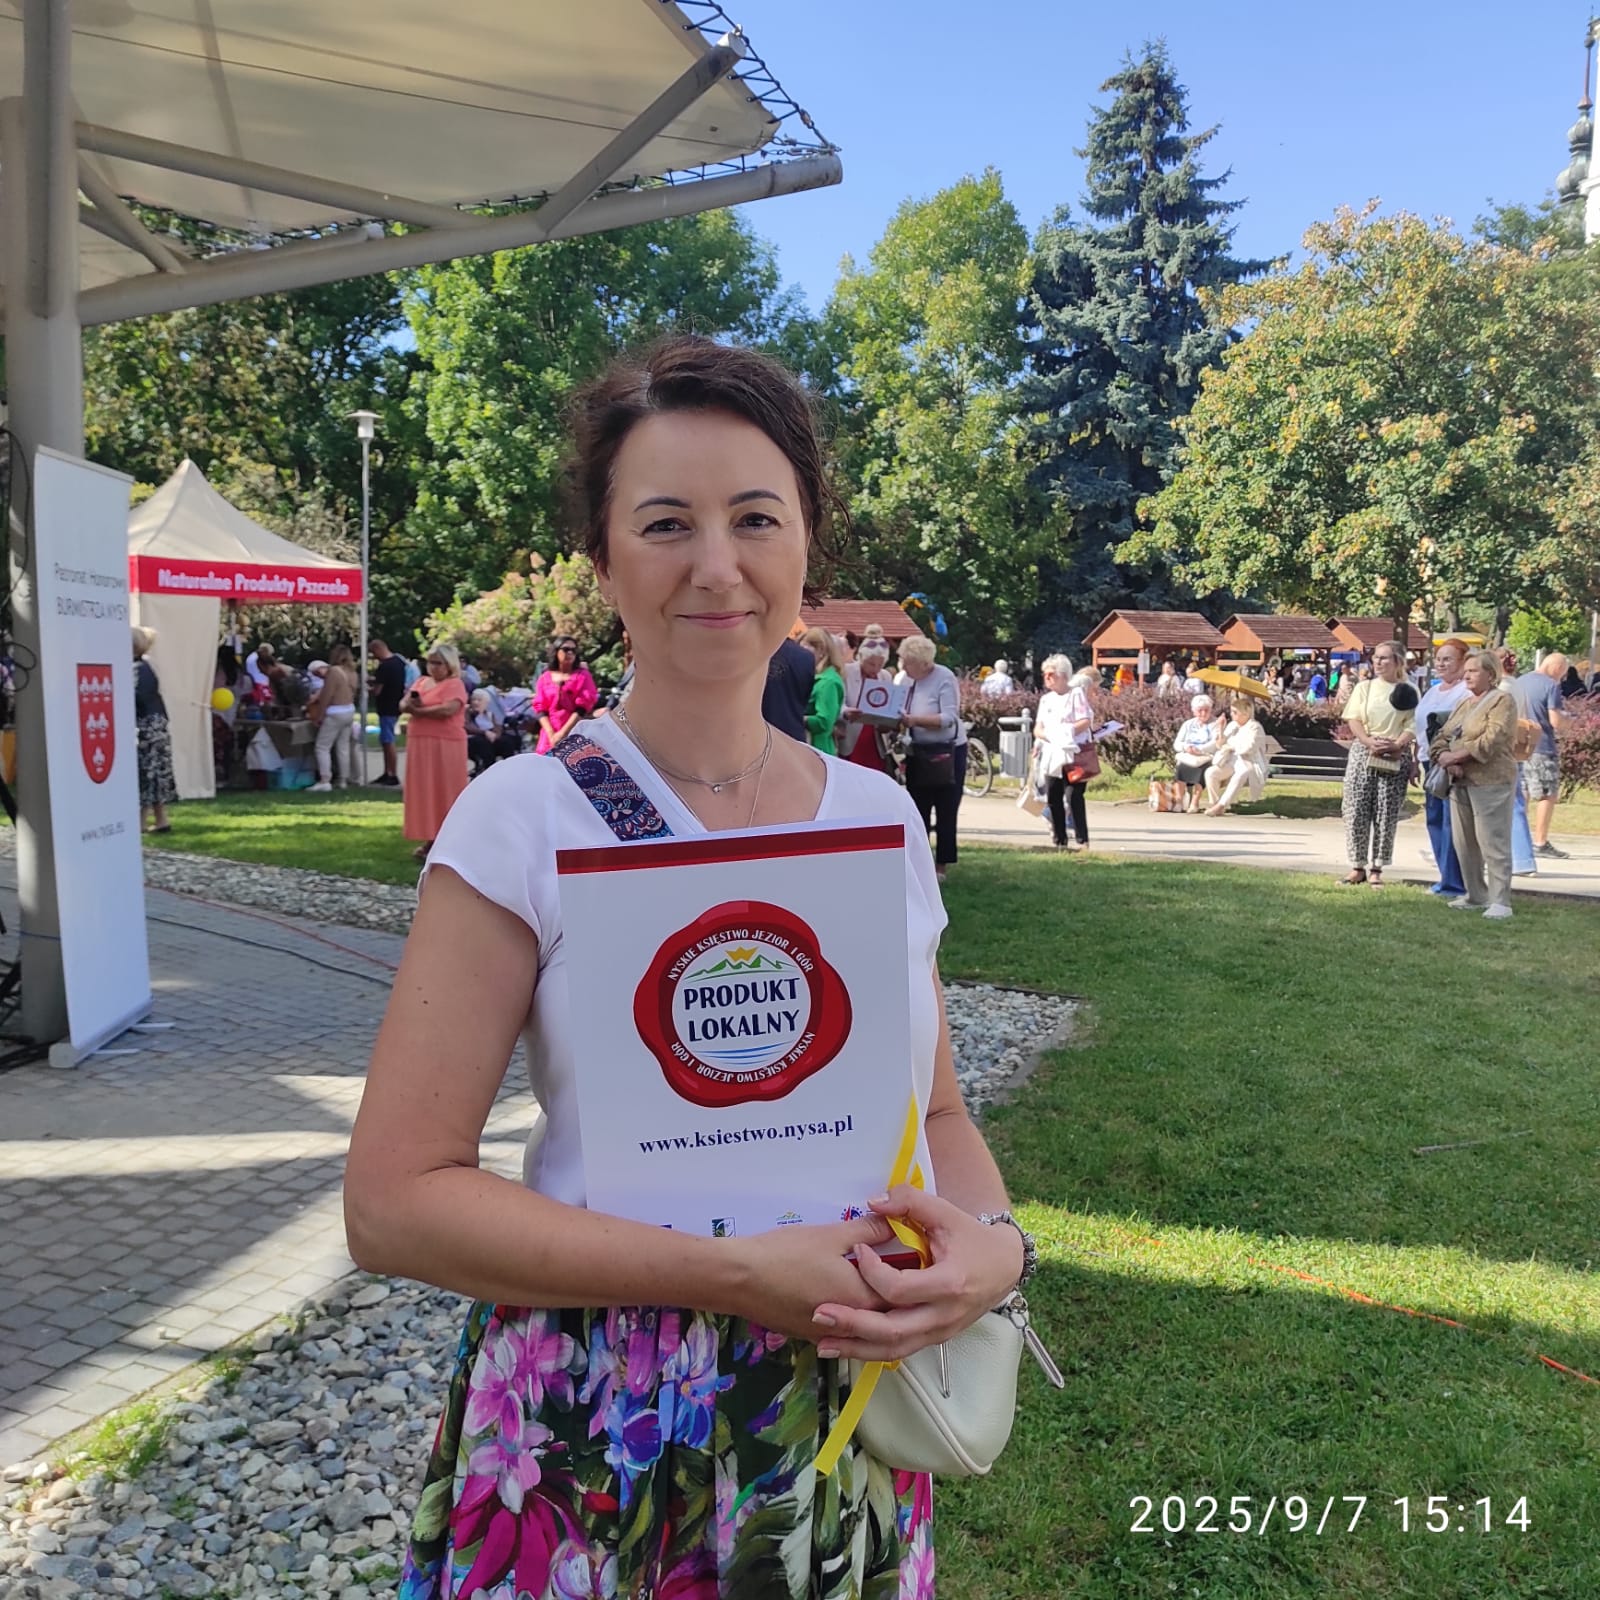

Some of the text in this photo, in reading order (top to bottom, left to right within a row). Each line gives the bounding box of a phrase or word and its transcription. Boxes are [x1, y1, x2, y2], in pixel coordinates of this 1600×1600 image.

[158, 568, 349, 597] Naturalne Produkty Pszczele
[667, 929, 814, 981] NYSKIE KSIĘSTWO JEZIOR I GÓR
[683, 977, 800, 1010] PRODUKT
[688, 1009, 800, 1042] LOKALNY
[671, 1031, 816, 1083] NYSKIE KSIĘSTWO JEZIOR I GÓR
[639, 1114, 854, 1154] www.ksiestwo.nysa.pl
